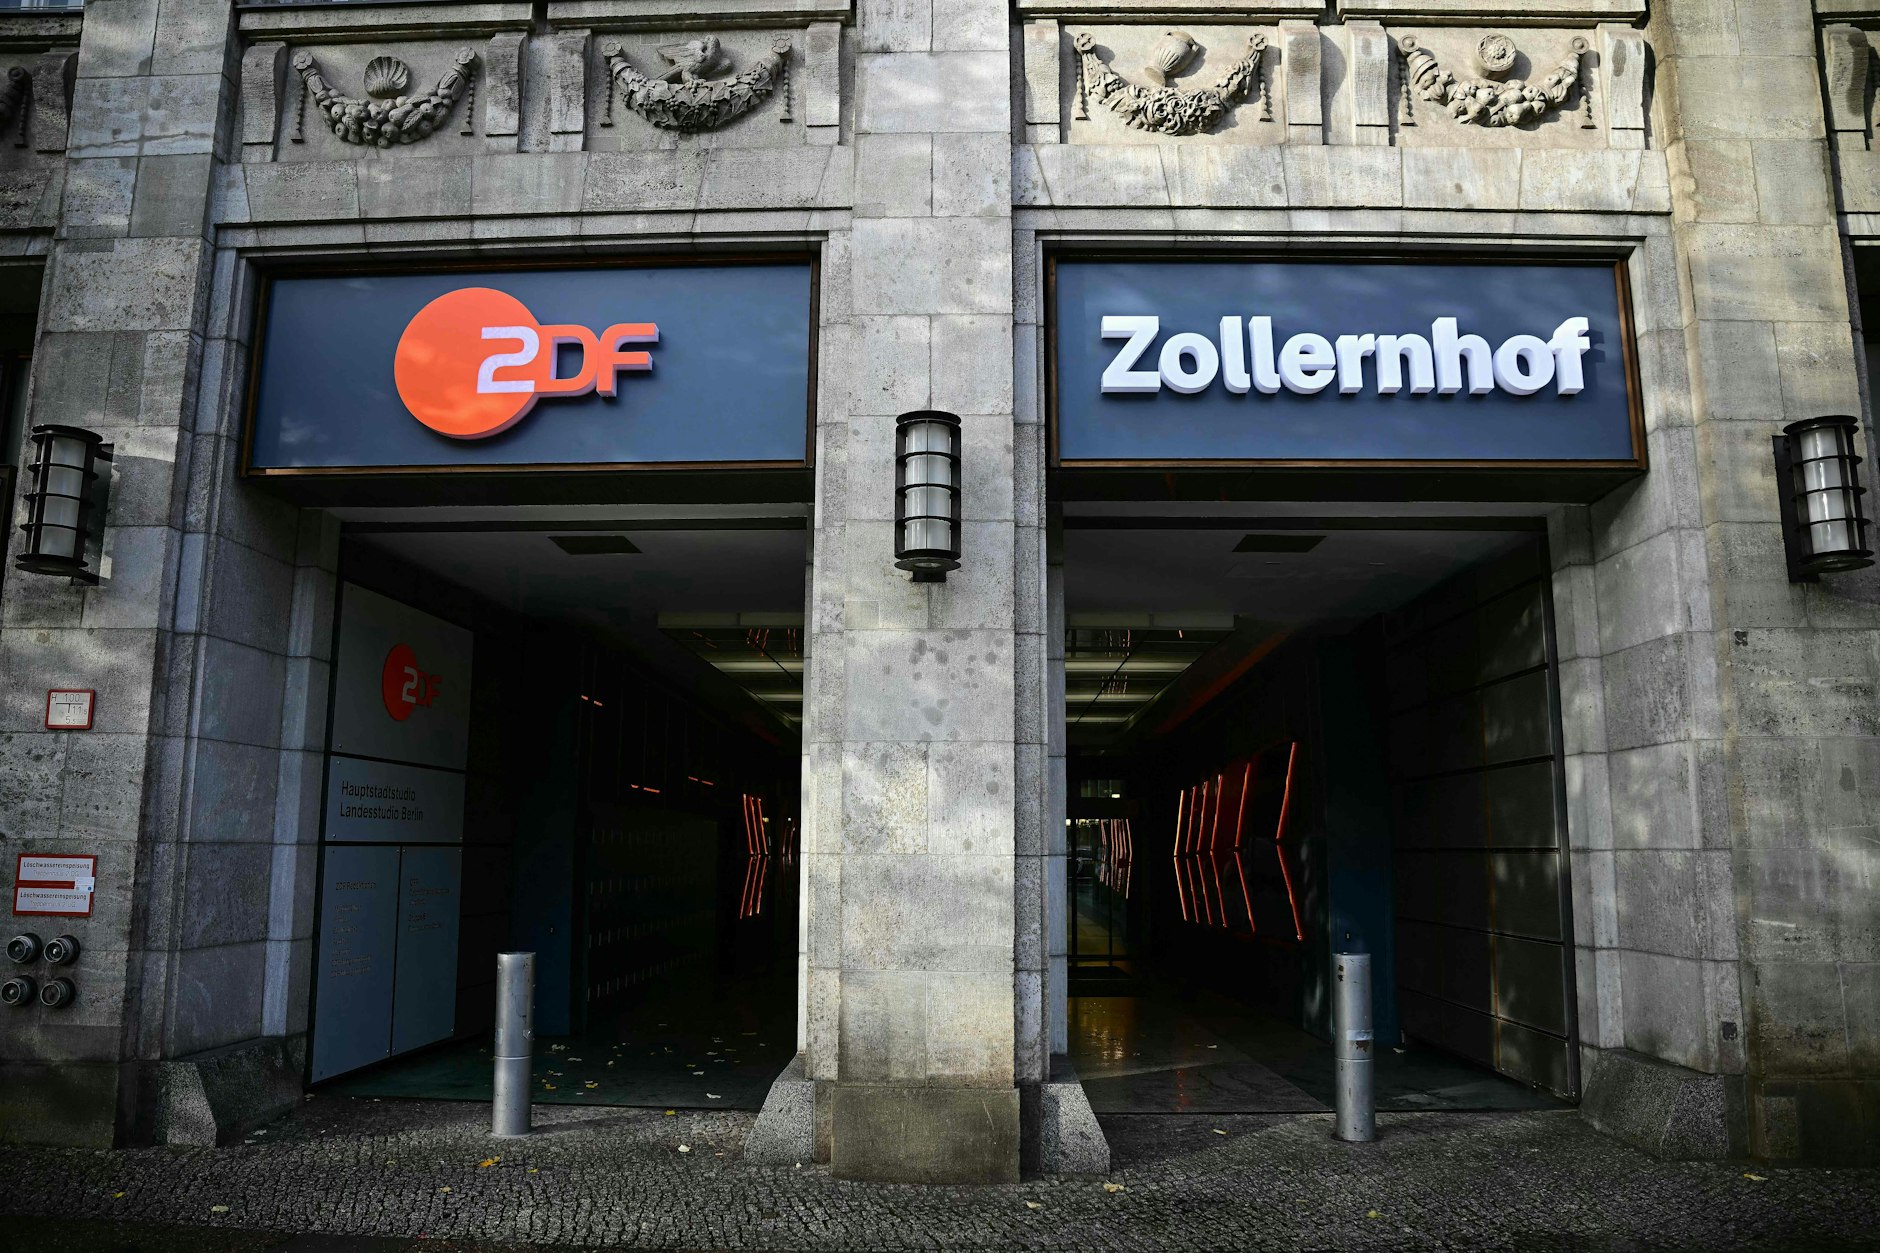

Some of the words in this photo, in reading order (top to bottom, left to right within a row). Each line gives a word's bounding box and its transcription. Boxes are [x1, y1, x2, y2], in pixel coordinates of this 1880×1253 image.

[1100, 315, 1591, 395] Zollernhof
[50, 693, 58, 702] H
[64, 693, 80, 702] 100
[341, 780, 416, 801] Hauptstadtstudio
[340, 802, 399, 820] Landesstudio
[401, 806, 423, 821] Berlin
[23, 861, 90, 870] Löschwassereinspeisung
[20, 891, 87, 901] Löschwassereinspeisung
